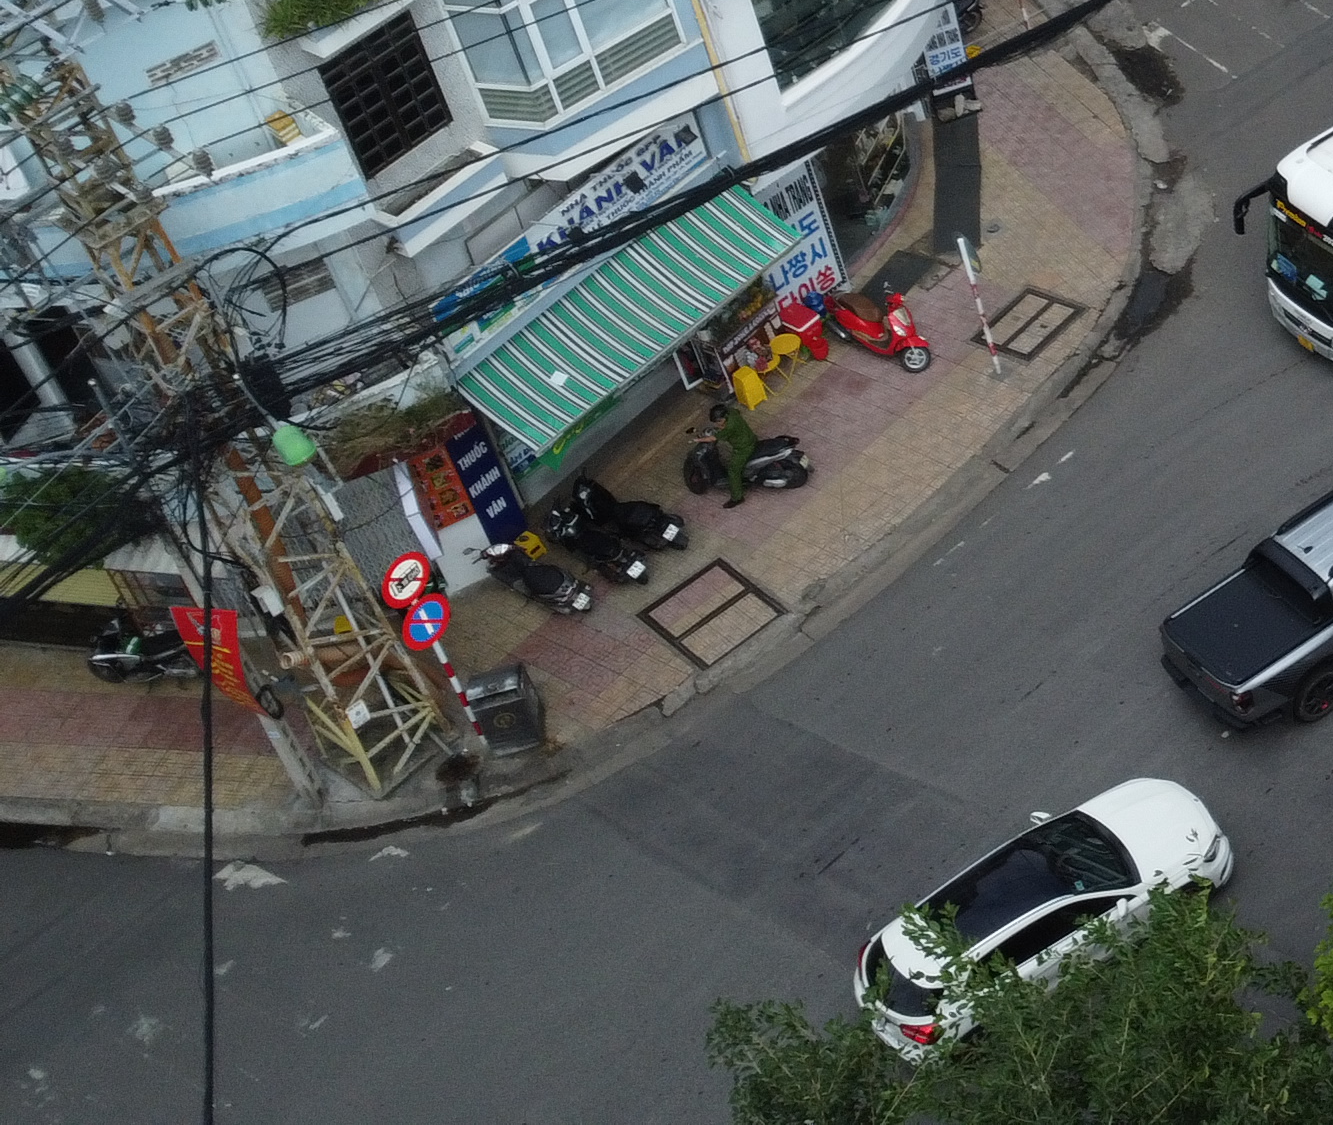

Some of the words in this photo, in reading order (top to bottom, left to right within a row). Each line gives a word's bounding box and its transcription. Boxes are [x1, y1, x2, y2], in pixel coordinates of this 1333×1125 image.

[785, 174, 814, 215] TRANG
[456, 440, 489, 471] THUỐC
[468, 465, 501, 499] KHÁNH
[485, 496, 508, 519] VÂN
